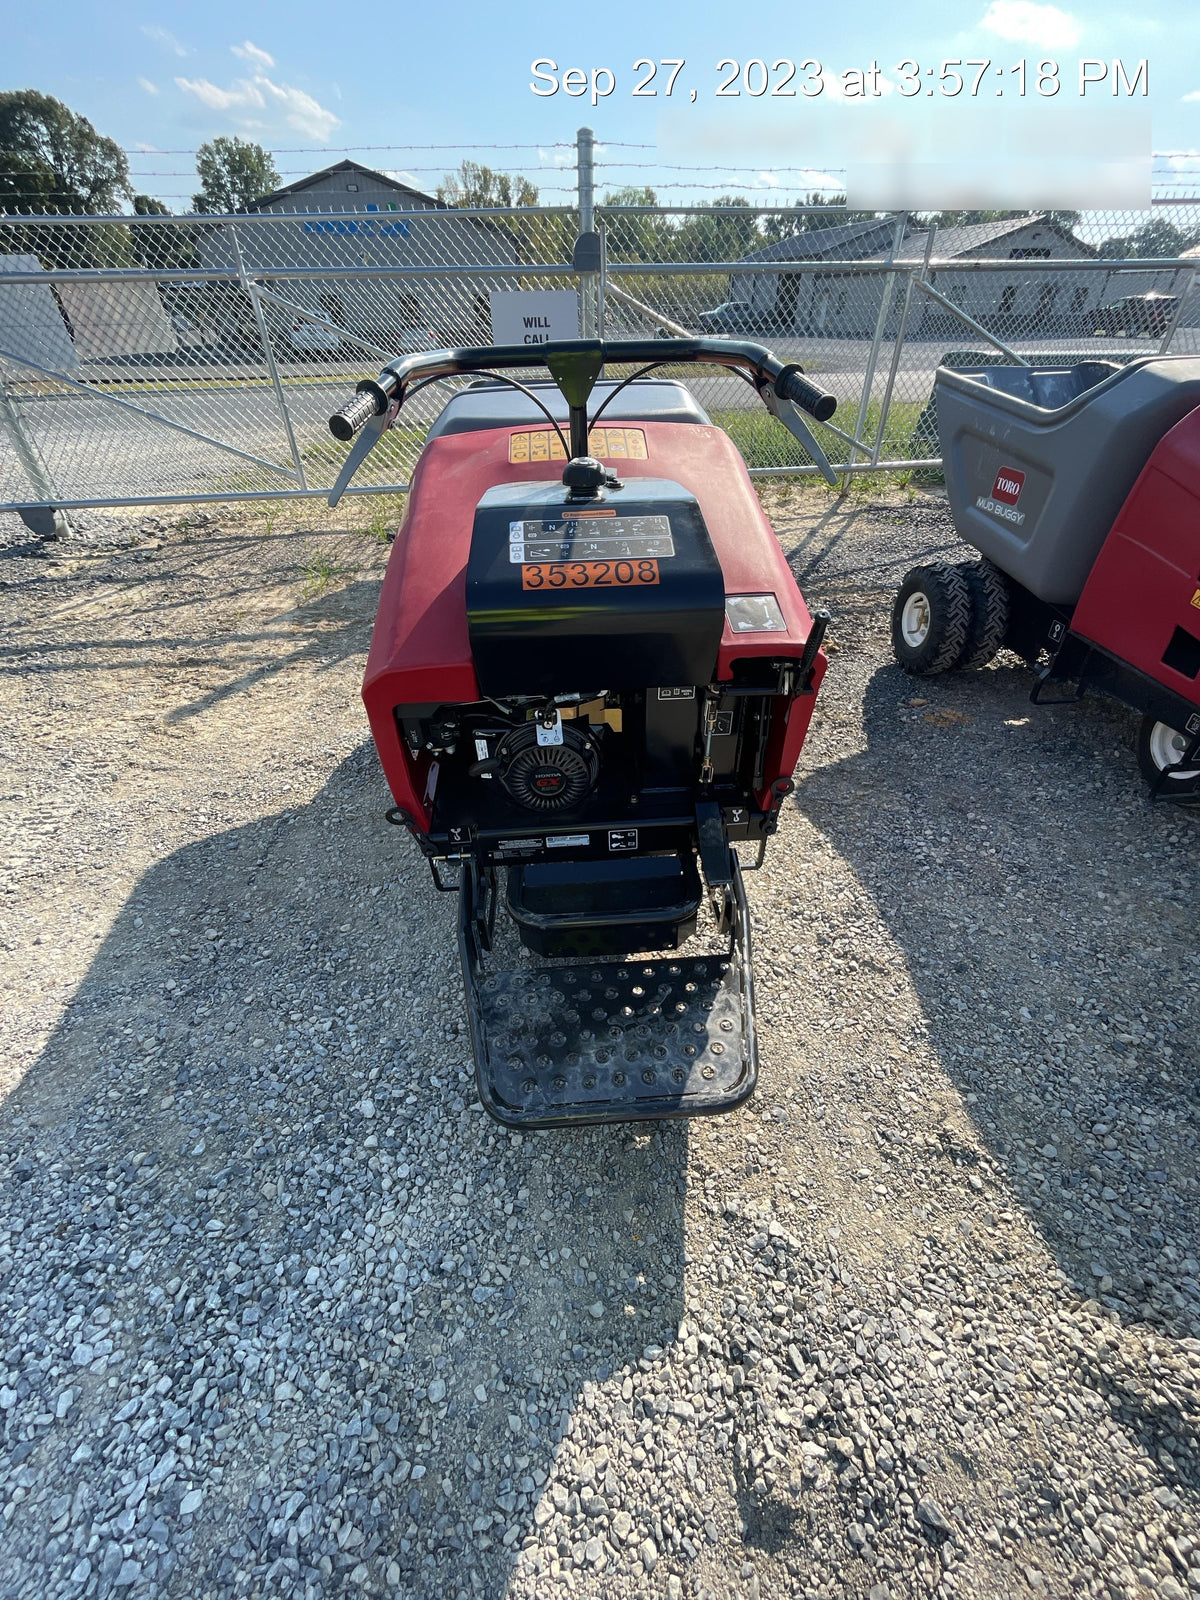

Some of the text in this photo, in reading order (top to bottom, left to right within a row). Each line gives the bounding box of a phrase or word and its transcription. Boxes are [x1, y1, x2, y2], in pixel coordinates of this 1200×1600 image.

[523, 317, 551, 328] WILL
[996, 477, 1020, 495] TORO
[976, 498, 1024, 523] MUD BUGGY
[525, 561, 657, 588] 353208
